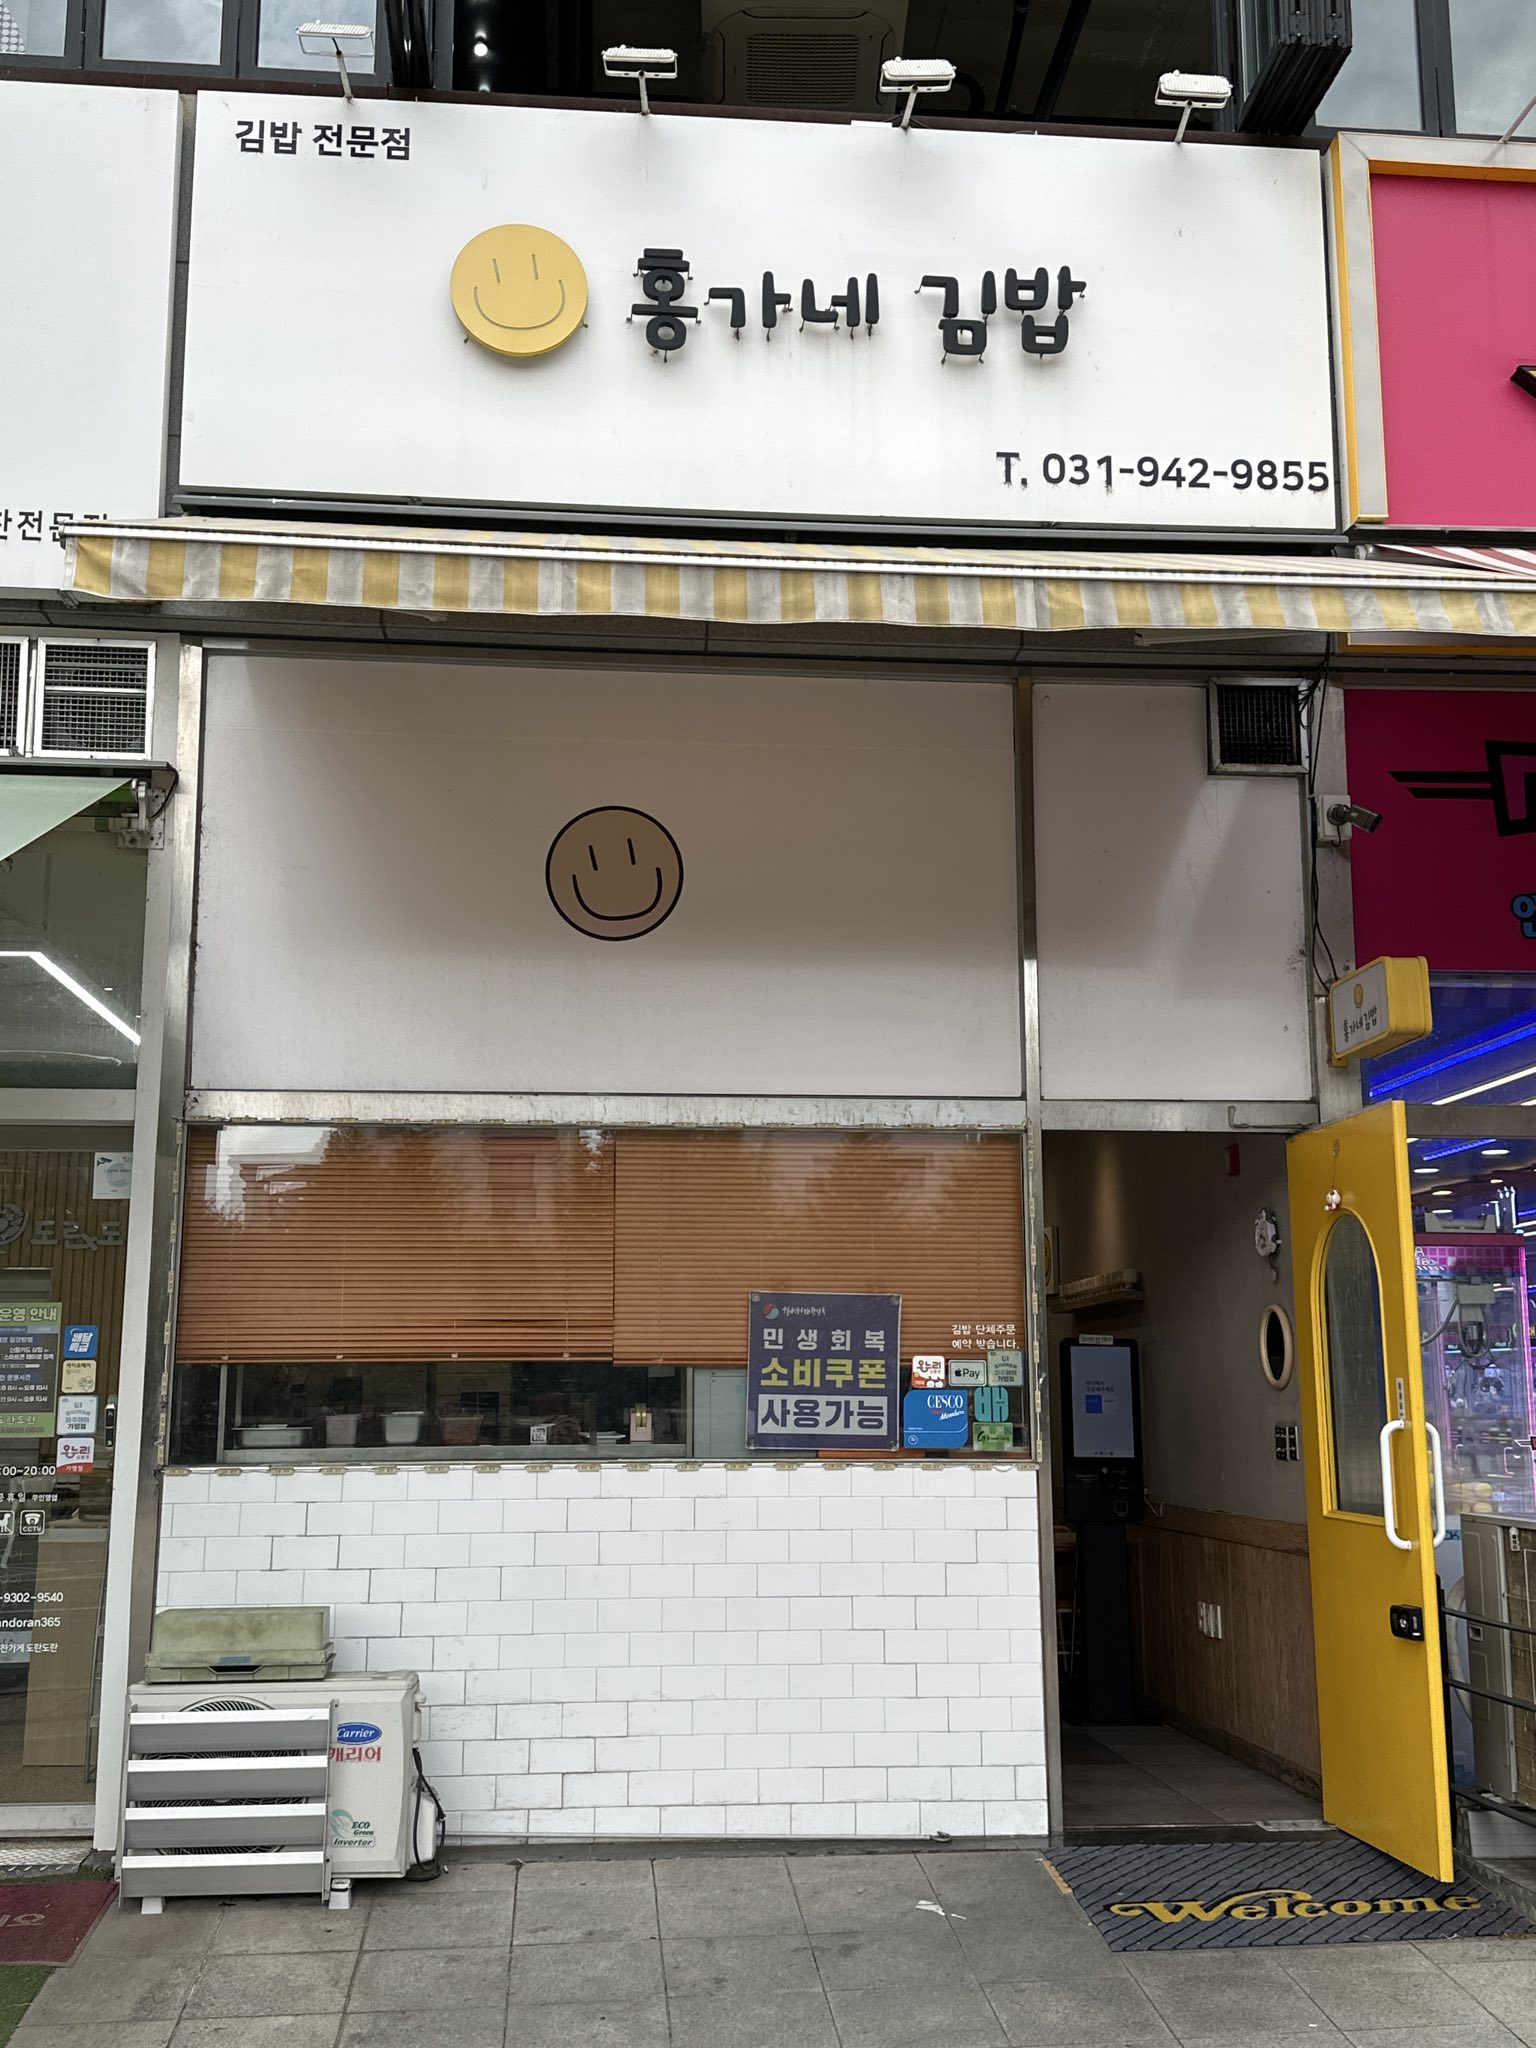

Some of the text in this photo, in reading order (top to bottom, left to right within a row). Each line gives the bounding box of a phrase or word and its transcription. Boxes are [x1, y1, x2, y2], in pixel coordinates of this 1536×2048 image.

[235, 120, 412, 161] 김밥 전문점
[631, 248, 1086, 355] 홍가네 김밥
[996, 452, 1329, 492] T. 031-942-9855
[30, 1308, 57, 1322] 안내
[952, 1324, 1016, 1335] 김밥 단체주문
[72, 1333, 93, 1343] 배달
[952, 1339, 1020, 1350] 예약 받습니다.
[917, 1360, 941, 1372] 온누리
[760, 1358, 887, 1389] 소비쿠폰
[963, 1368, 980, 1380] Pay
[927, 1394, 963, 1409] CESCO
[761, 1399, 884, 1430] 사용가능
[61, 1444, 90, 1459] 온누리
[25, 1643, 59, 1653] 도란도란
[338, 1728, 375, 1738] Carrier
[334, 1838, 373, 1847] Inverter
[1110, 1888, 1481, 1923] Welcome
